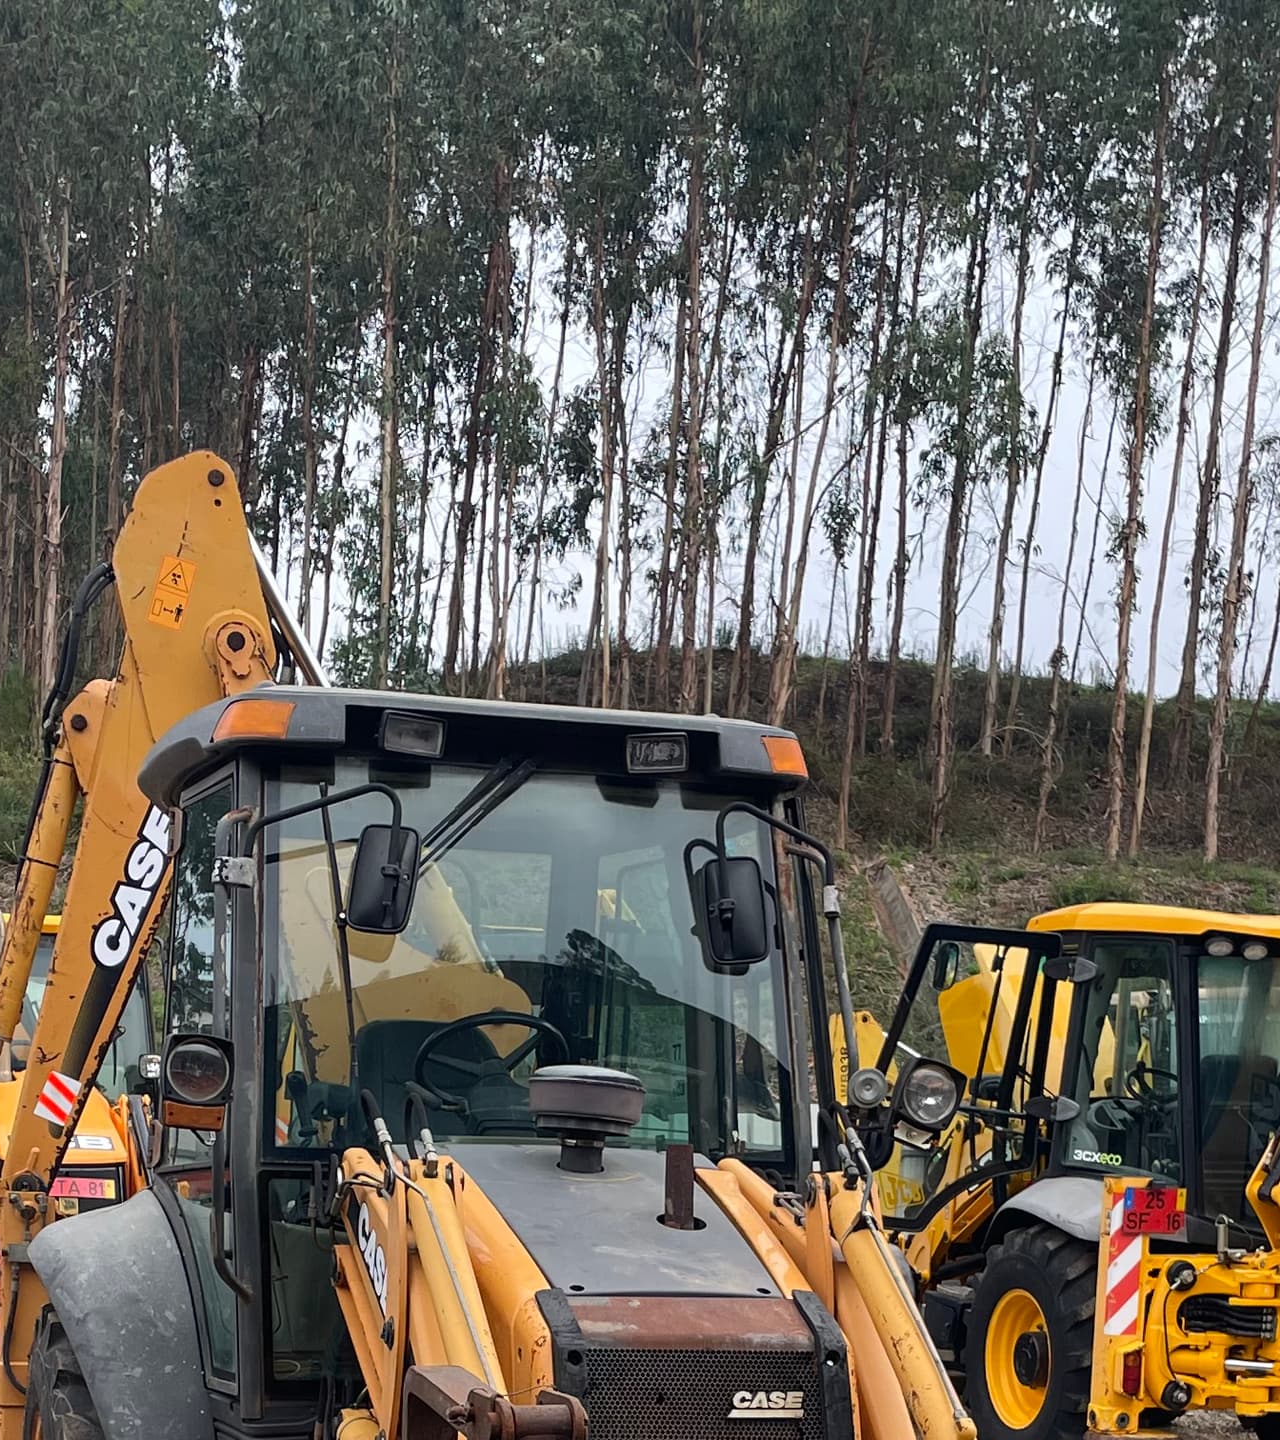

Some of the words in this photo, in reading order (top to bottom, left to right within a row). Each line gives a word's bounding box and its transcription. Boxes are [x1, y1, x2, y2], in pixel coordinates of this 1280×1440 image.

[94, 805, 170, 967] CASE
[88, 1182, 105, 1196] 81
[1145, 1191, 1165, 1210] 25
[1126, 1212, 1151, 1230] SF
[1166, 1213, 1181, 1231] 16
[732, 1391, 804, 1409] CASE
